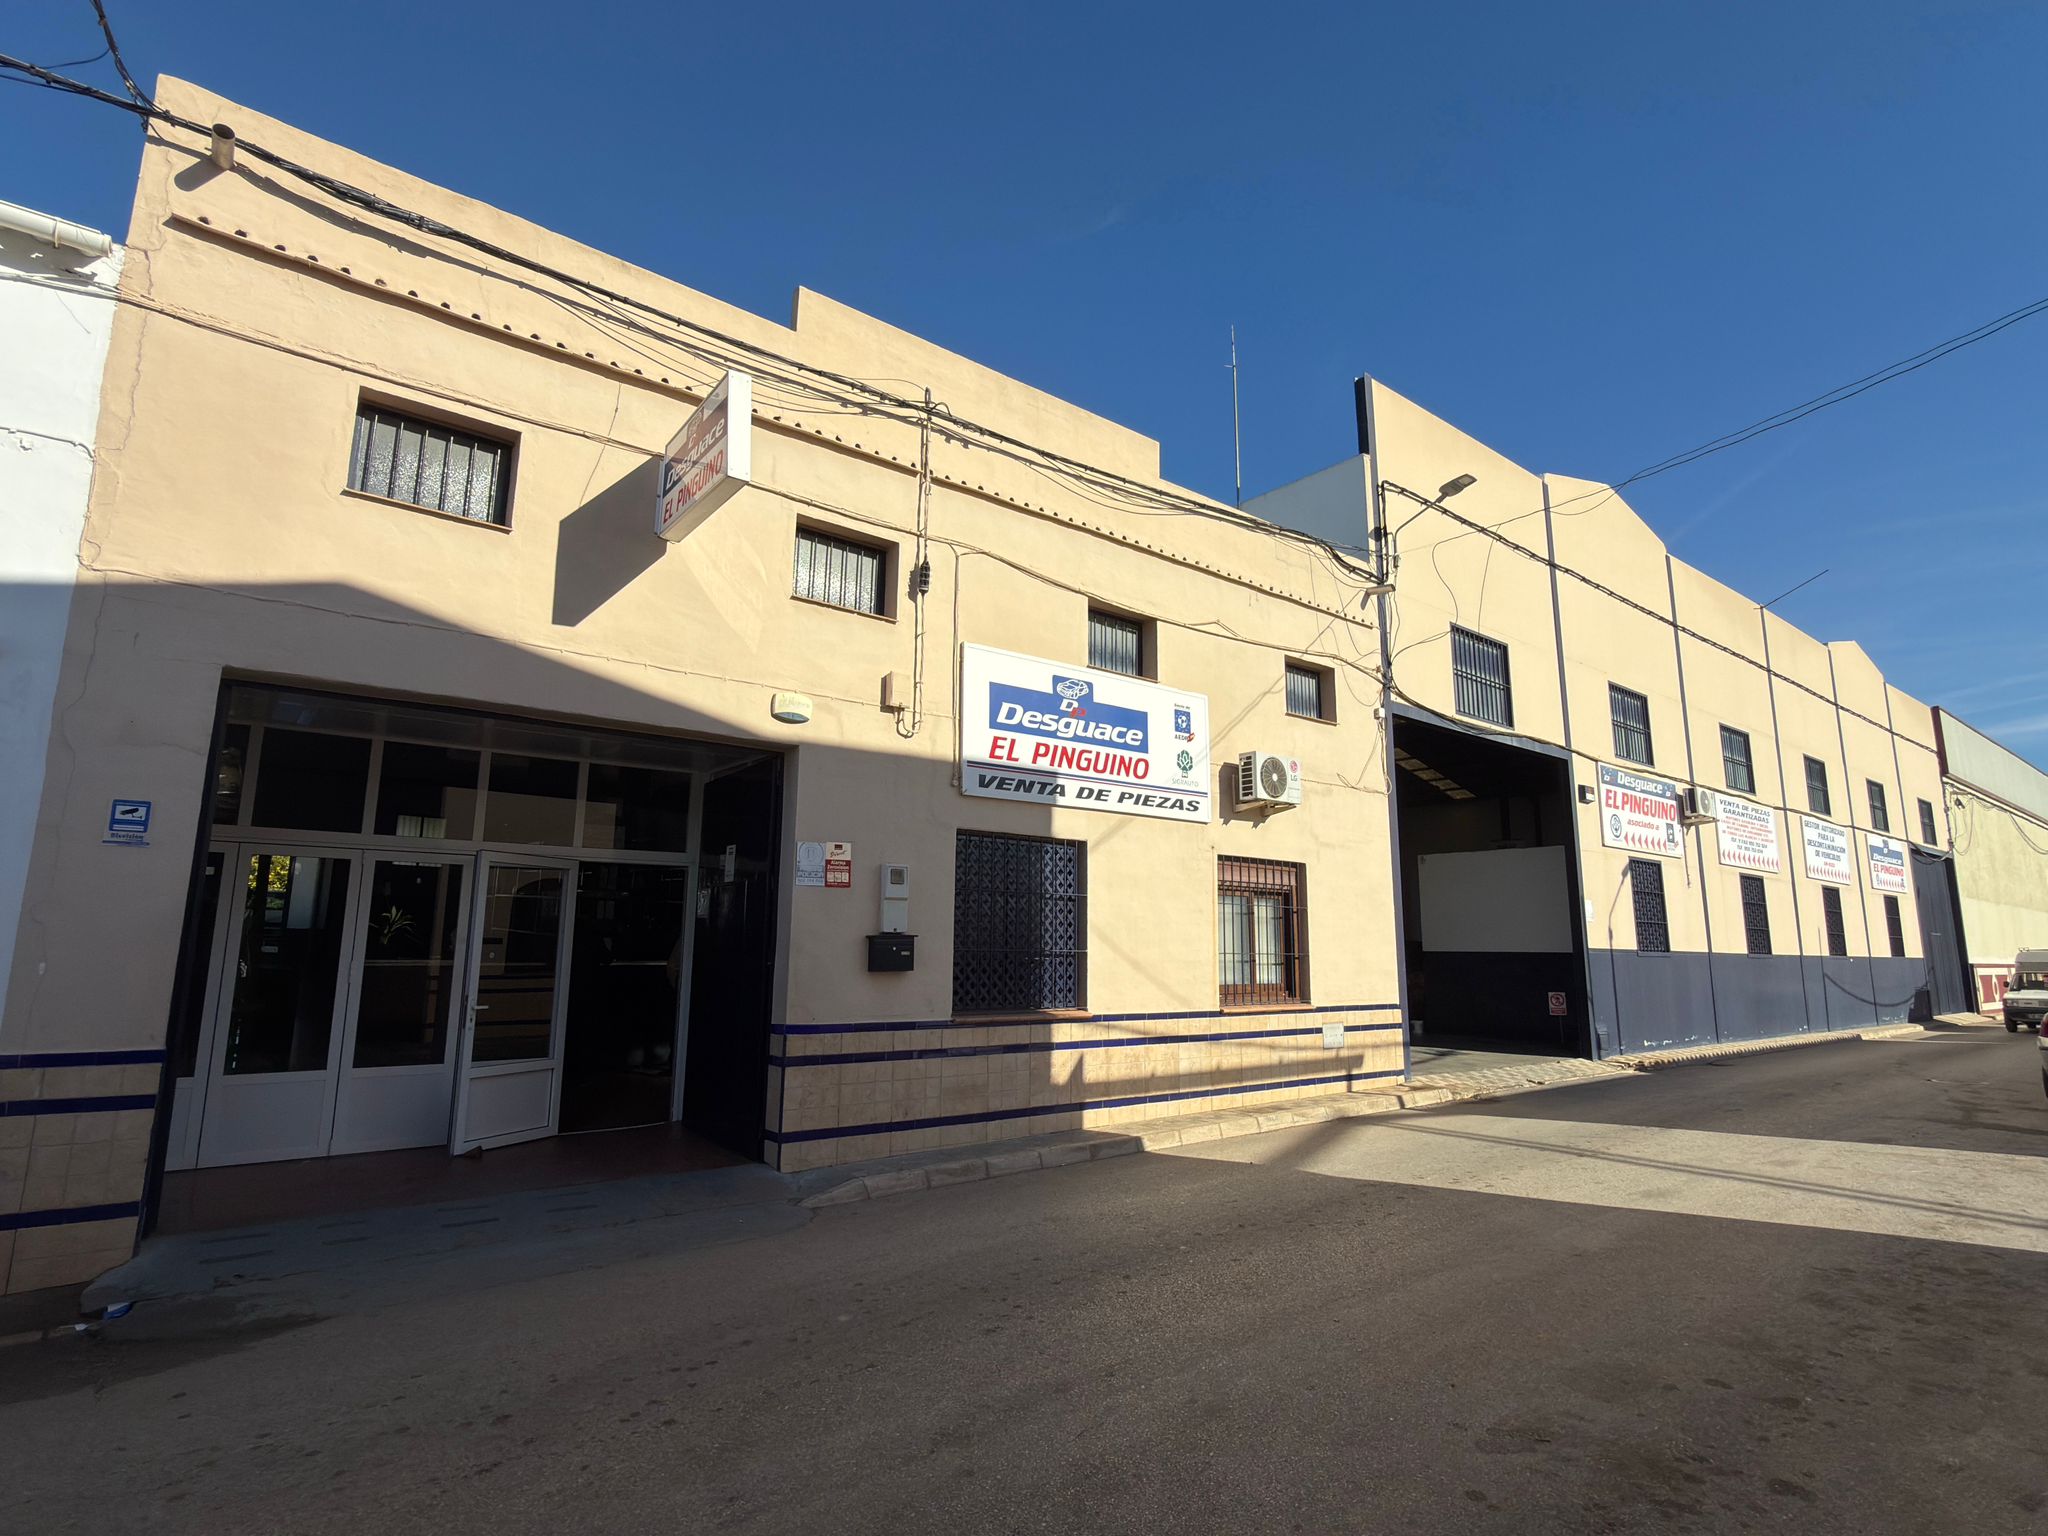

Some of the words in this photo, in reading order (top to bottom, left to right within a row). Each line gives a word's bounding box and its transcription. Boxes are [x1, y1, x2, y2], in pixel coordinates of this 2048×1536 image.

[665, 418, 725, 490] Desguace
[663, 498, 673, 523] EL
[676, 450, 723, 512] PINGUINO
[996, 701, 1143, 746] Desguace
[989, 735, 1019, 762] EL
[1031, 742, 1149, 780] PINGUINO
[978, 774, 1066, 797] VENTA
[1075, 786, 1111, 802] DE
[1117, 791, 1201, 812] PIEZAS
[1617, 771, 1663, 794] Desguace
[1605, 788, 1619, 810] EL
[1621, 792, 1676, 822] PINGUINO
[1719, 799, 1740, 809] VENTA
[1751, 807, 1771, 818] PIEZAS
[1723, 807, 1770, 824] GARANTIZADAS
[1627, 819, 1655, 830] asociado
[1874, 862, 1880, 872] EL
[1880, 864, 1904, 877] PINGUINO
